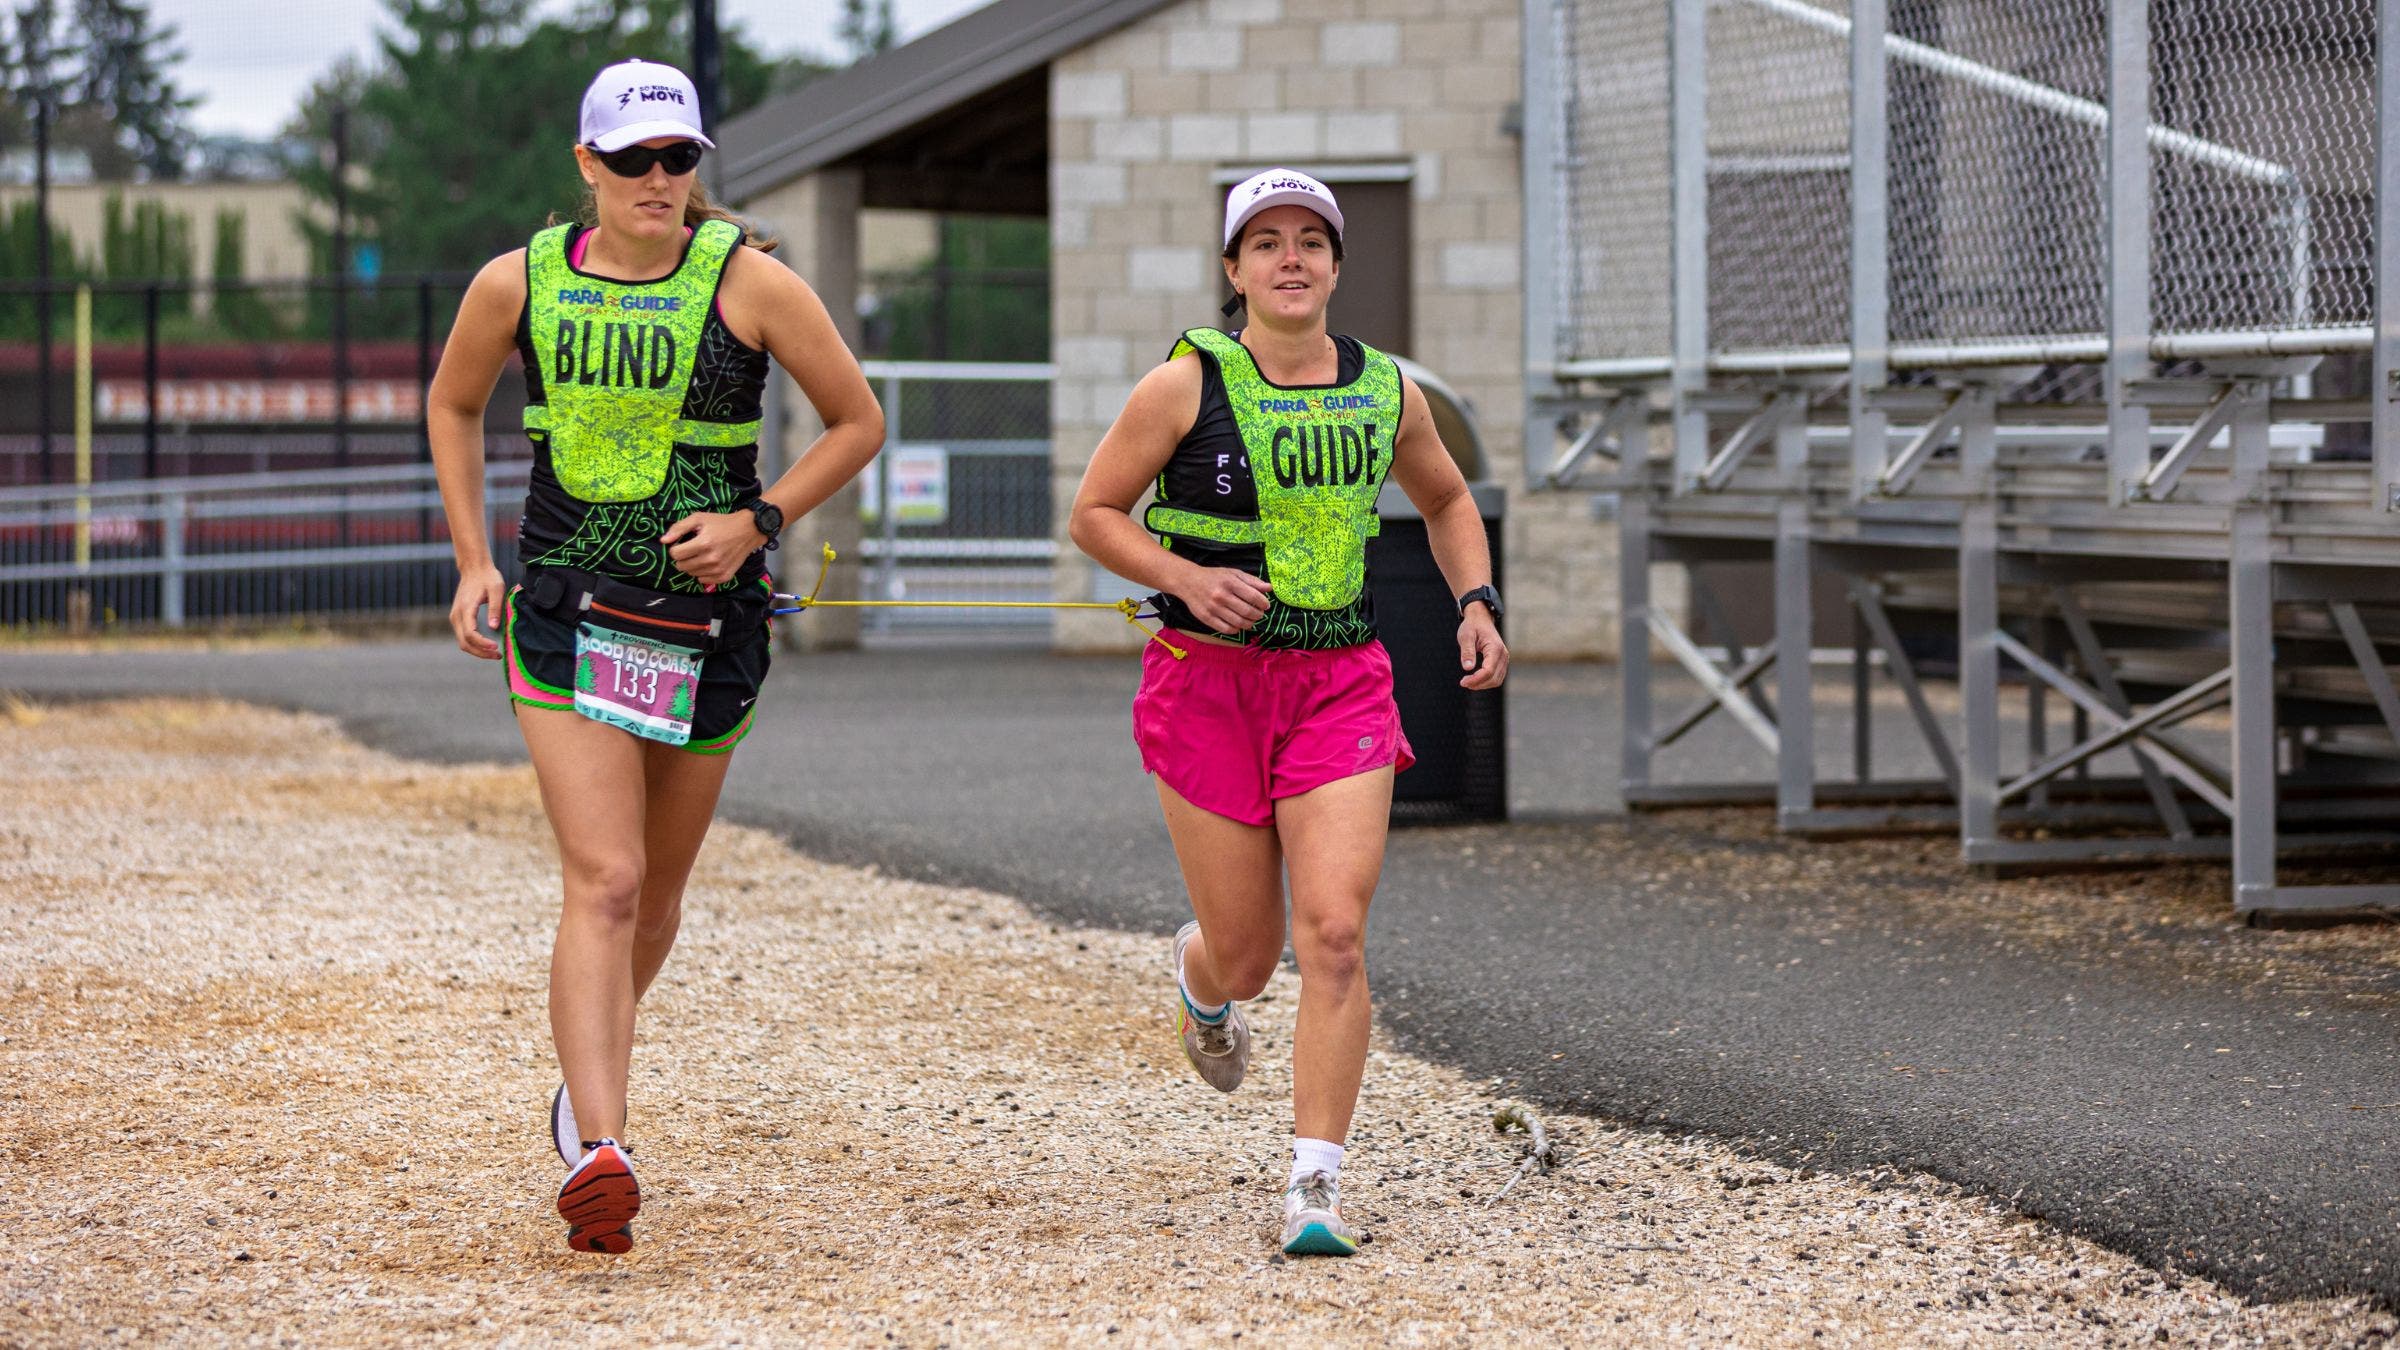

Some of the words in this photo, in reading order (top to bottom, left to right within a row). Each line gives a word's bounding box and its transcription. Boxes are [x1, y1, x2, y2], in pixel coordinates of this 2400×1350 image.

[640, 91, 685, 105] MOVE
[559, 289, 604, 306] PARA
[620, 295, 681, 311] GUIDE
[555, 319, 676, 389] BLIND
[1259, 399, 1310, 413] PARA
[1323, 395, 1377, 410] GUIDE
[1272, 423, 1379, 489] GUIDE
[580, 638, 624, 660] HOOD
[625, 646, 648, 665] TO
[619, 634, 667, 650] PROVIDENCE
[612, 659, 658, 705] 133
